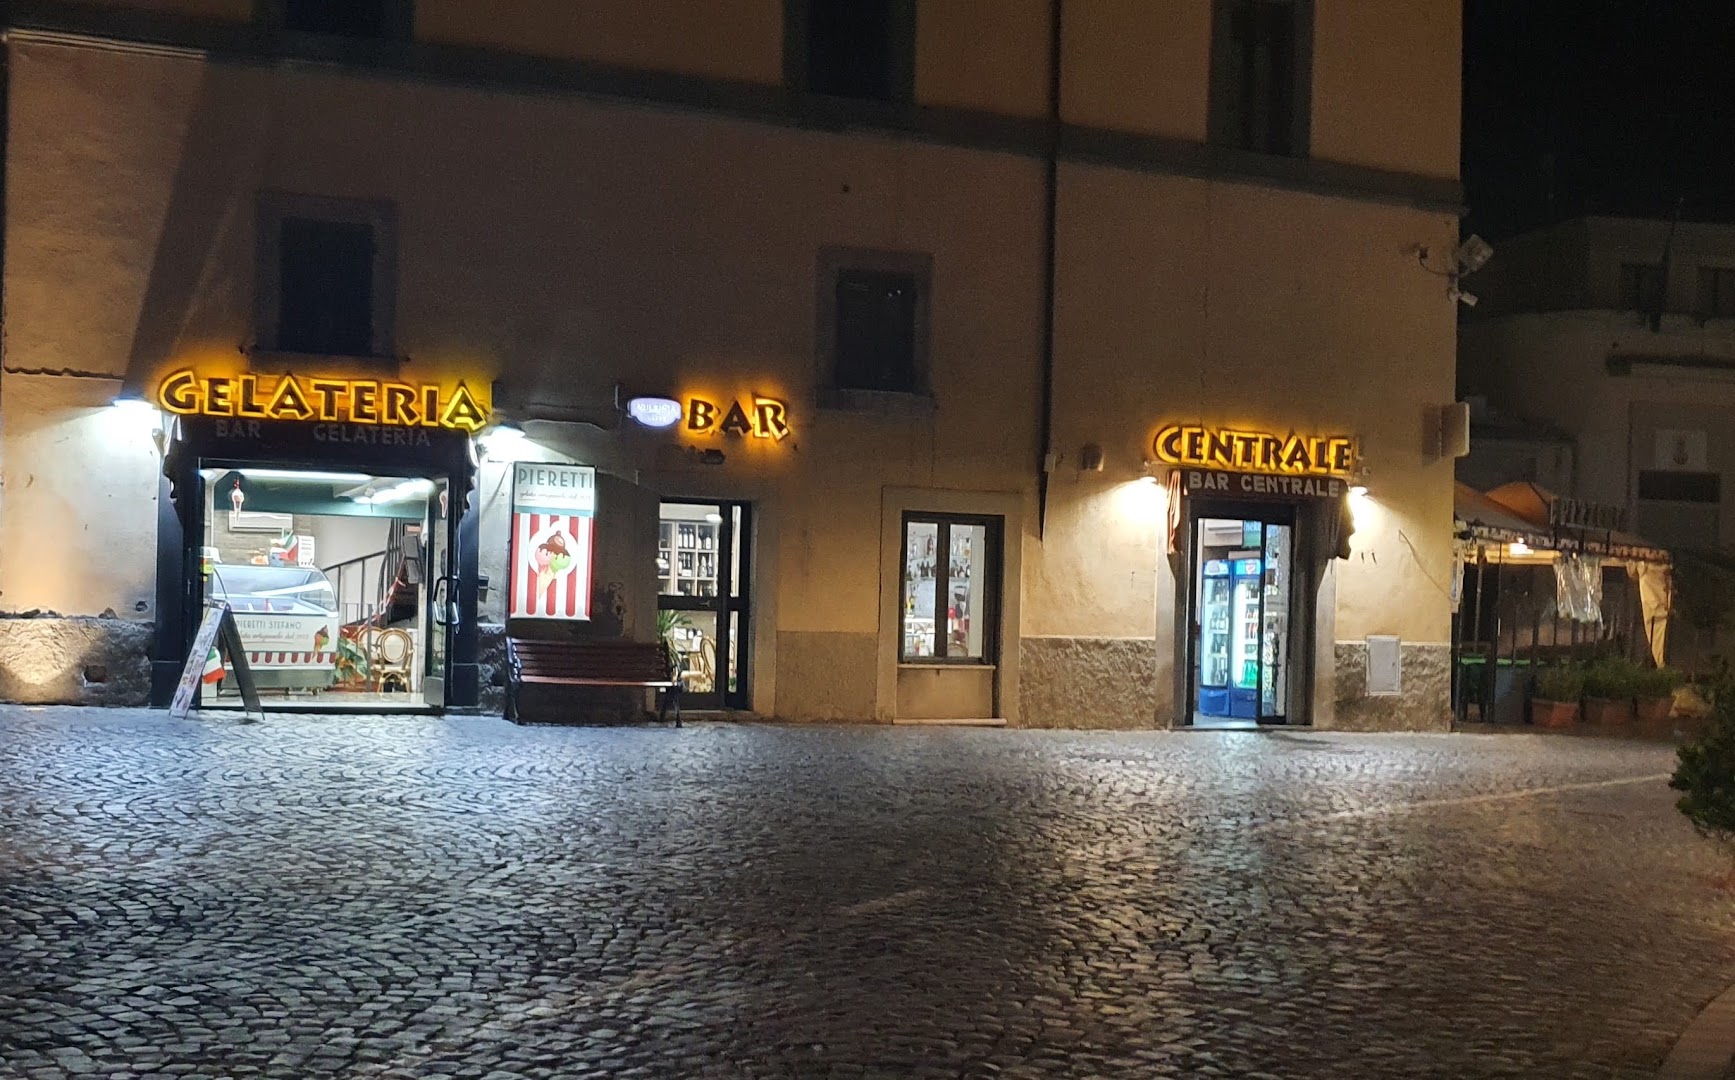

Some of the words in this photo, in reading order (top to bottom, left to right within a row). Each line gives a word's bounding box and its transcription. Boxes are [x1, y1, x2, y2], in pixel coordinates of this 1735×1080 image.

[158, 369, 487, 432] GELATERIA
[688, 393, 790, 441] BAR
[215, 419, 261, 438] BAR
[313, 423, 431, 447] GELATERIA
[1153, 425, 1352, 475] CENTRALE
[518, 468, 593, 489] PIERETTI
[1188, 472, 1229, 491] BAR
[1240, 474, 1340, 499] CENTRALE
[269, 620, 302, 630] STEFANO
